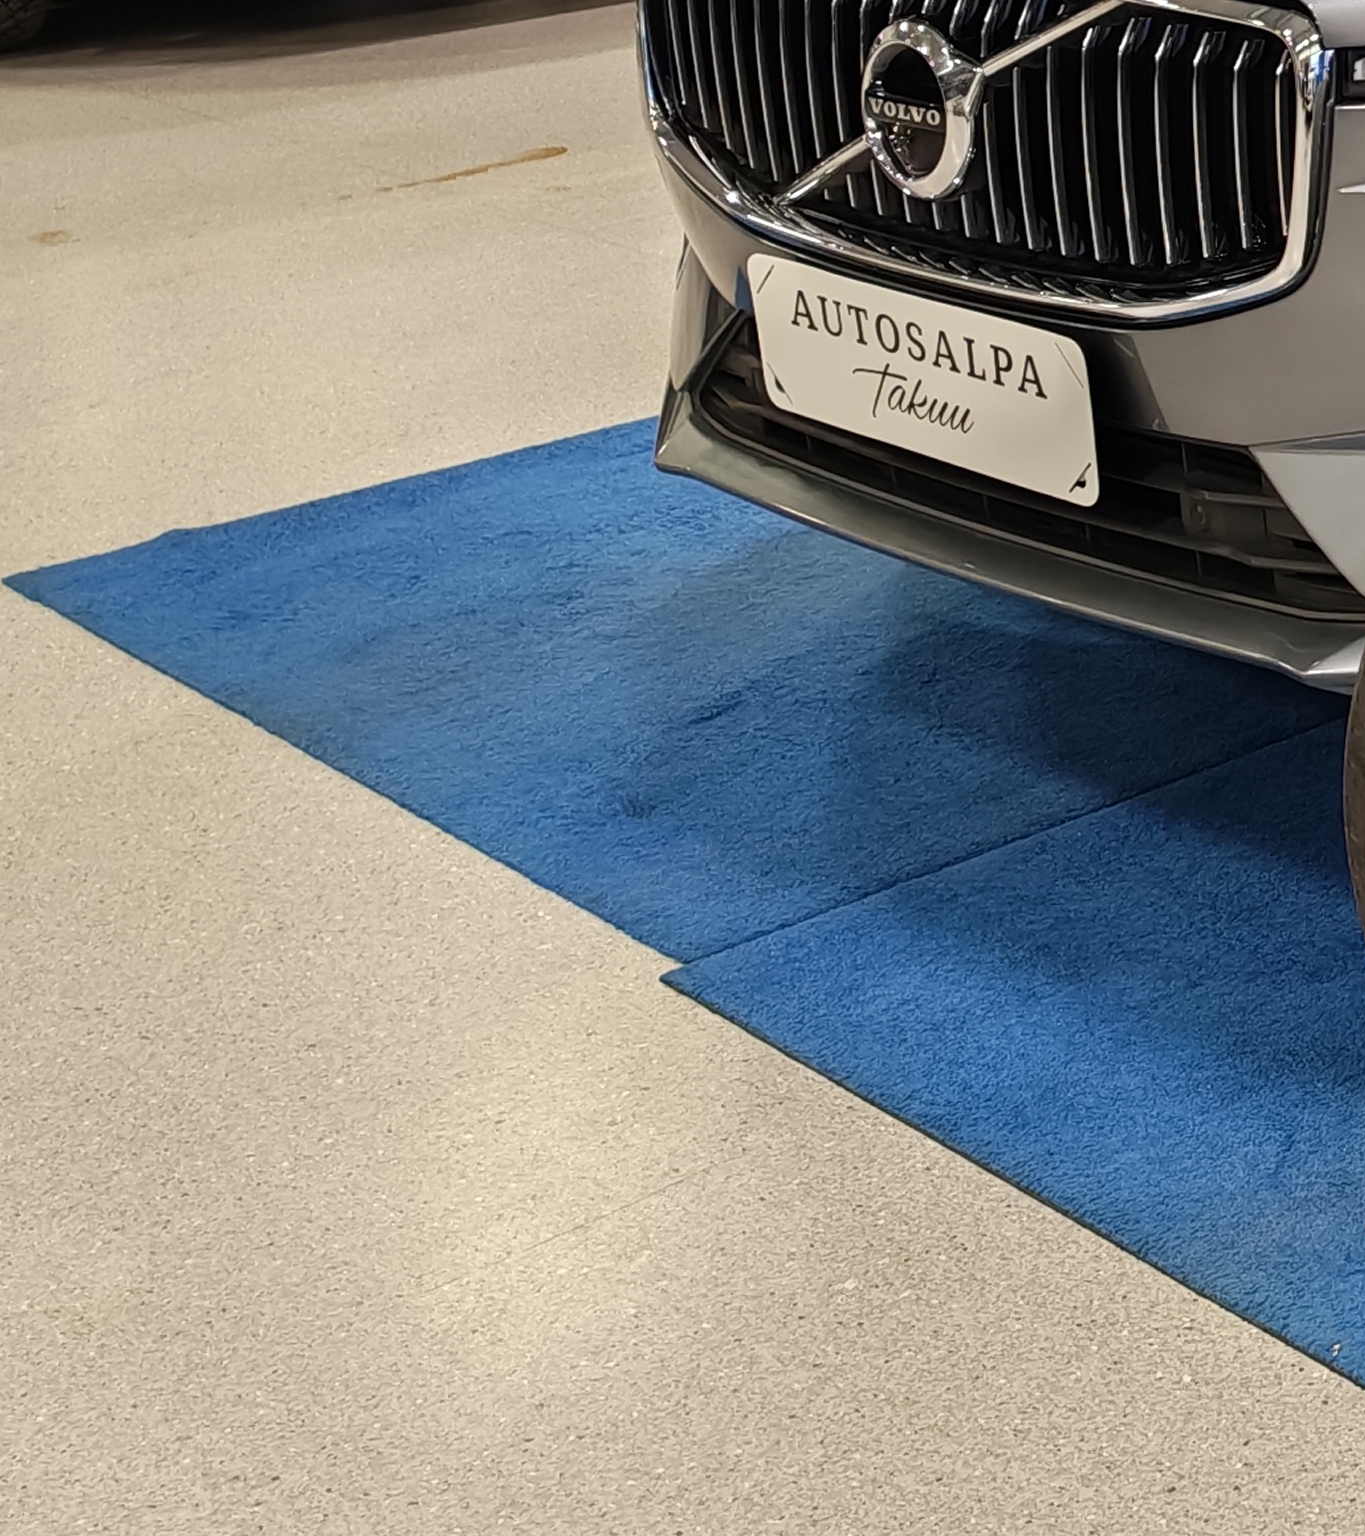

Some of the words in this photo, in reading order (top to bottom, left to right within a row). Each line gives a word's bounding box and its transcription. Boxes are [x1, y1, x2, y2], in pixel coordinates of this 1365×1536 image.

[867, 96, 941, 126] VOLVO
[791, 290, 1048, 399] AUTOSALPA
[852, 363, 975, 434] Takuu
